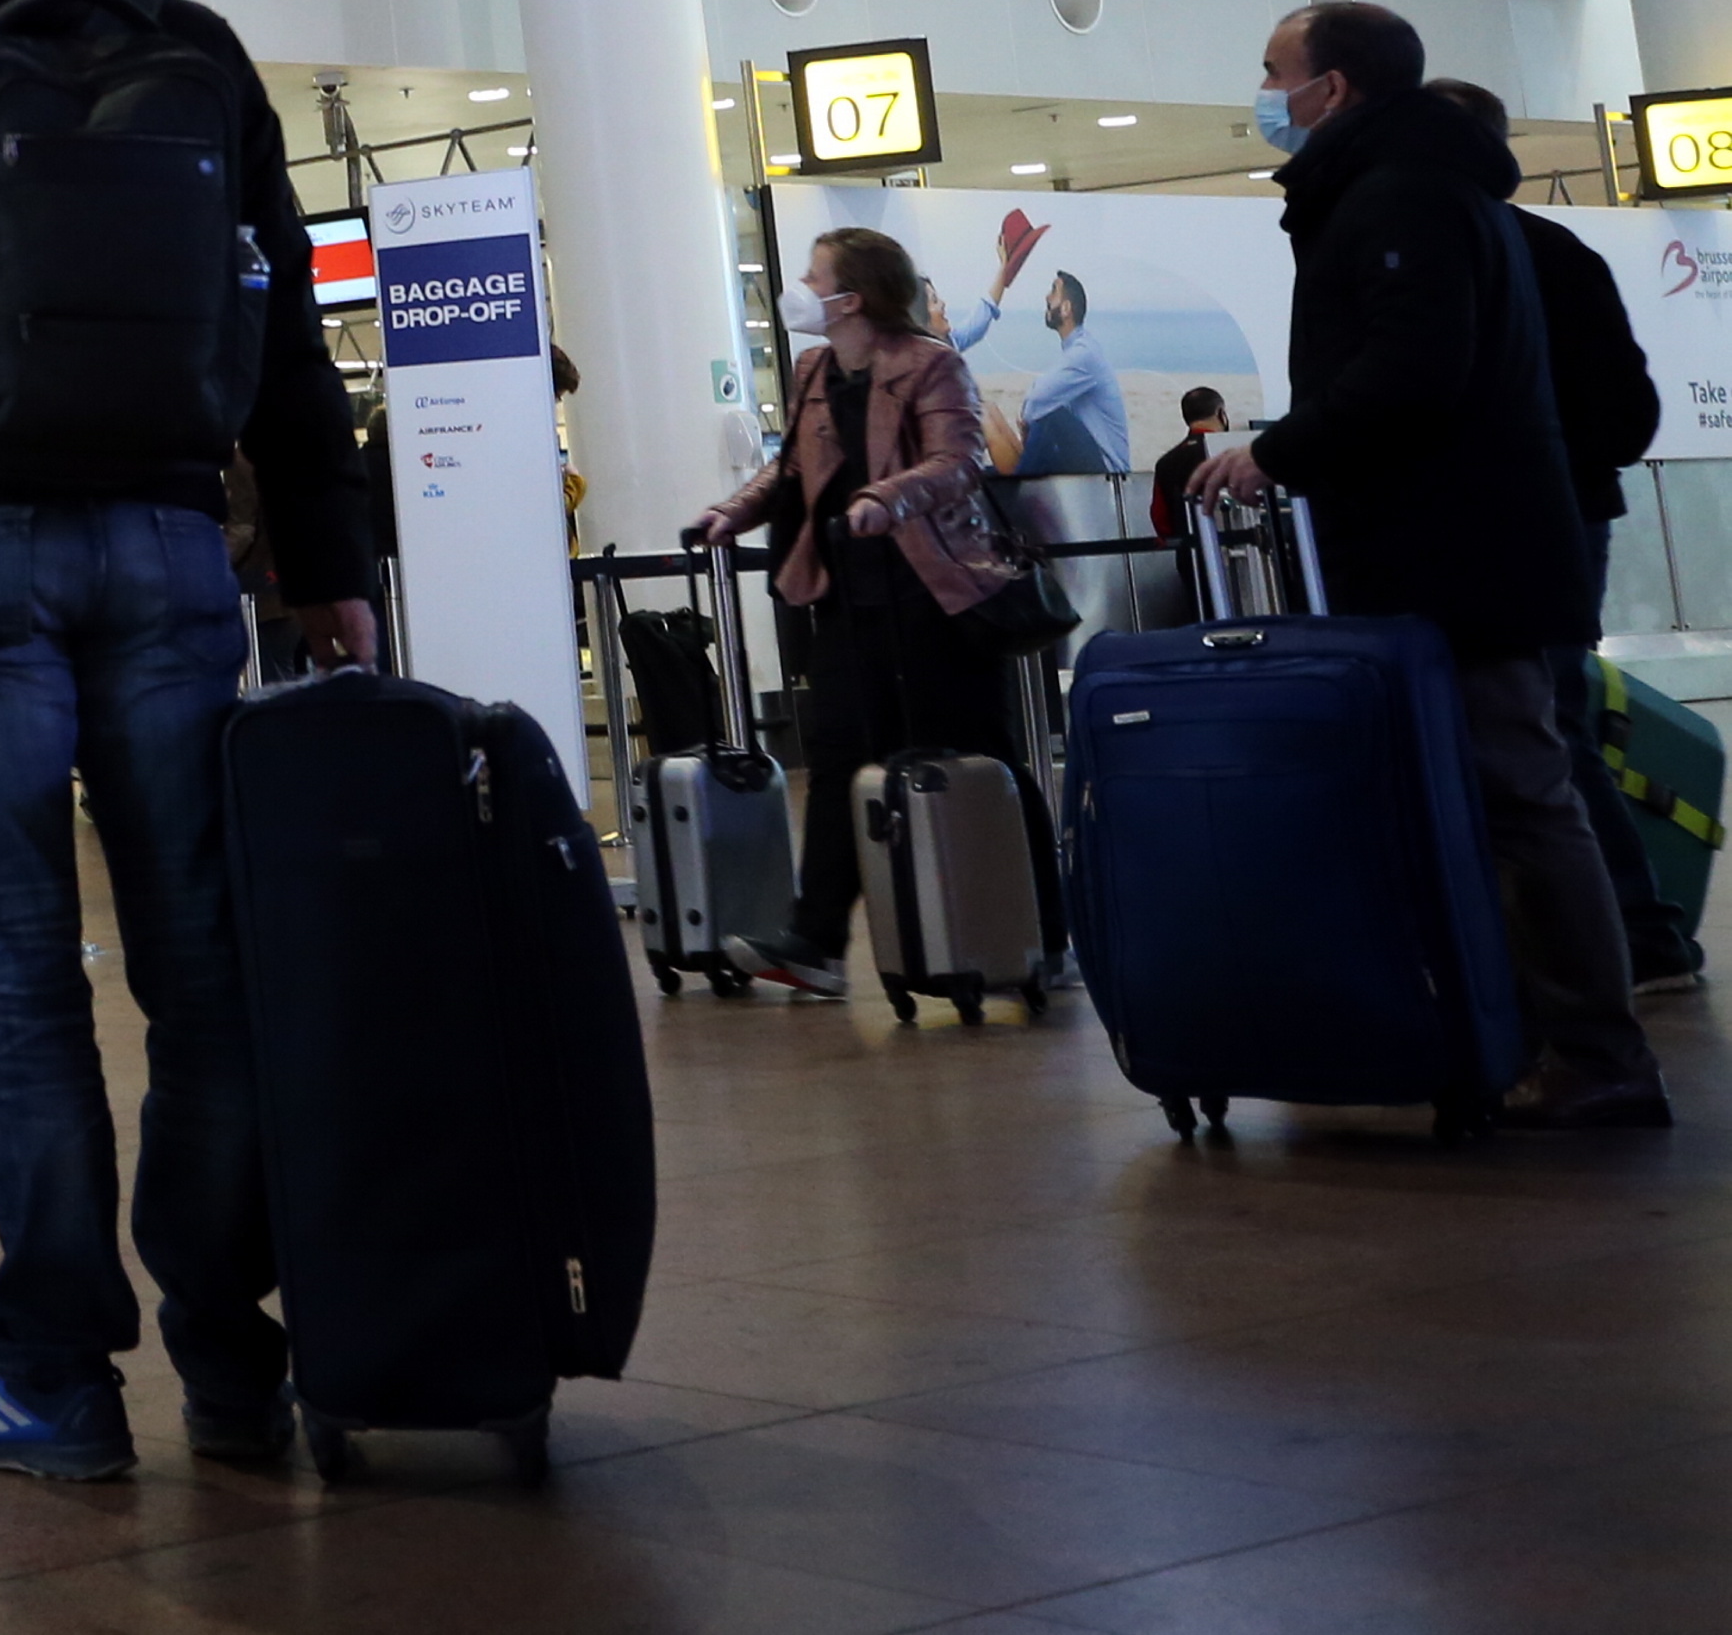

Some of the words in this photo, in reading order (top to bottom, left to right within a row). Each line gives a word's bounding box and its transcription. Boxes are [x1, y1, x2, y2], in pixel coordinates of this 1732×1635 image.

[827, 92, 899, 141] 07
[1669, 130, 1732, 173] 08
[422, 197, 514, 218] SKYTEAM
[388, 272, 526, 304] BAGGAGE
[392, 299, 522, 330] DROP-OFF
[1688, 380, 1726, 404] Take
[423, 489, 445, 498] KLM
